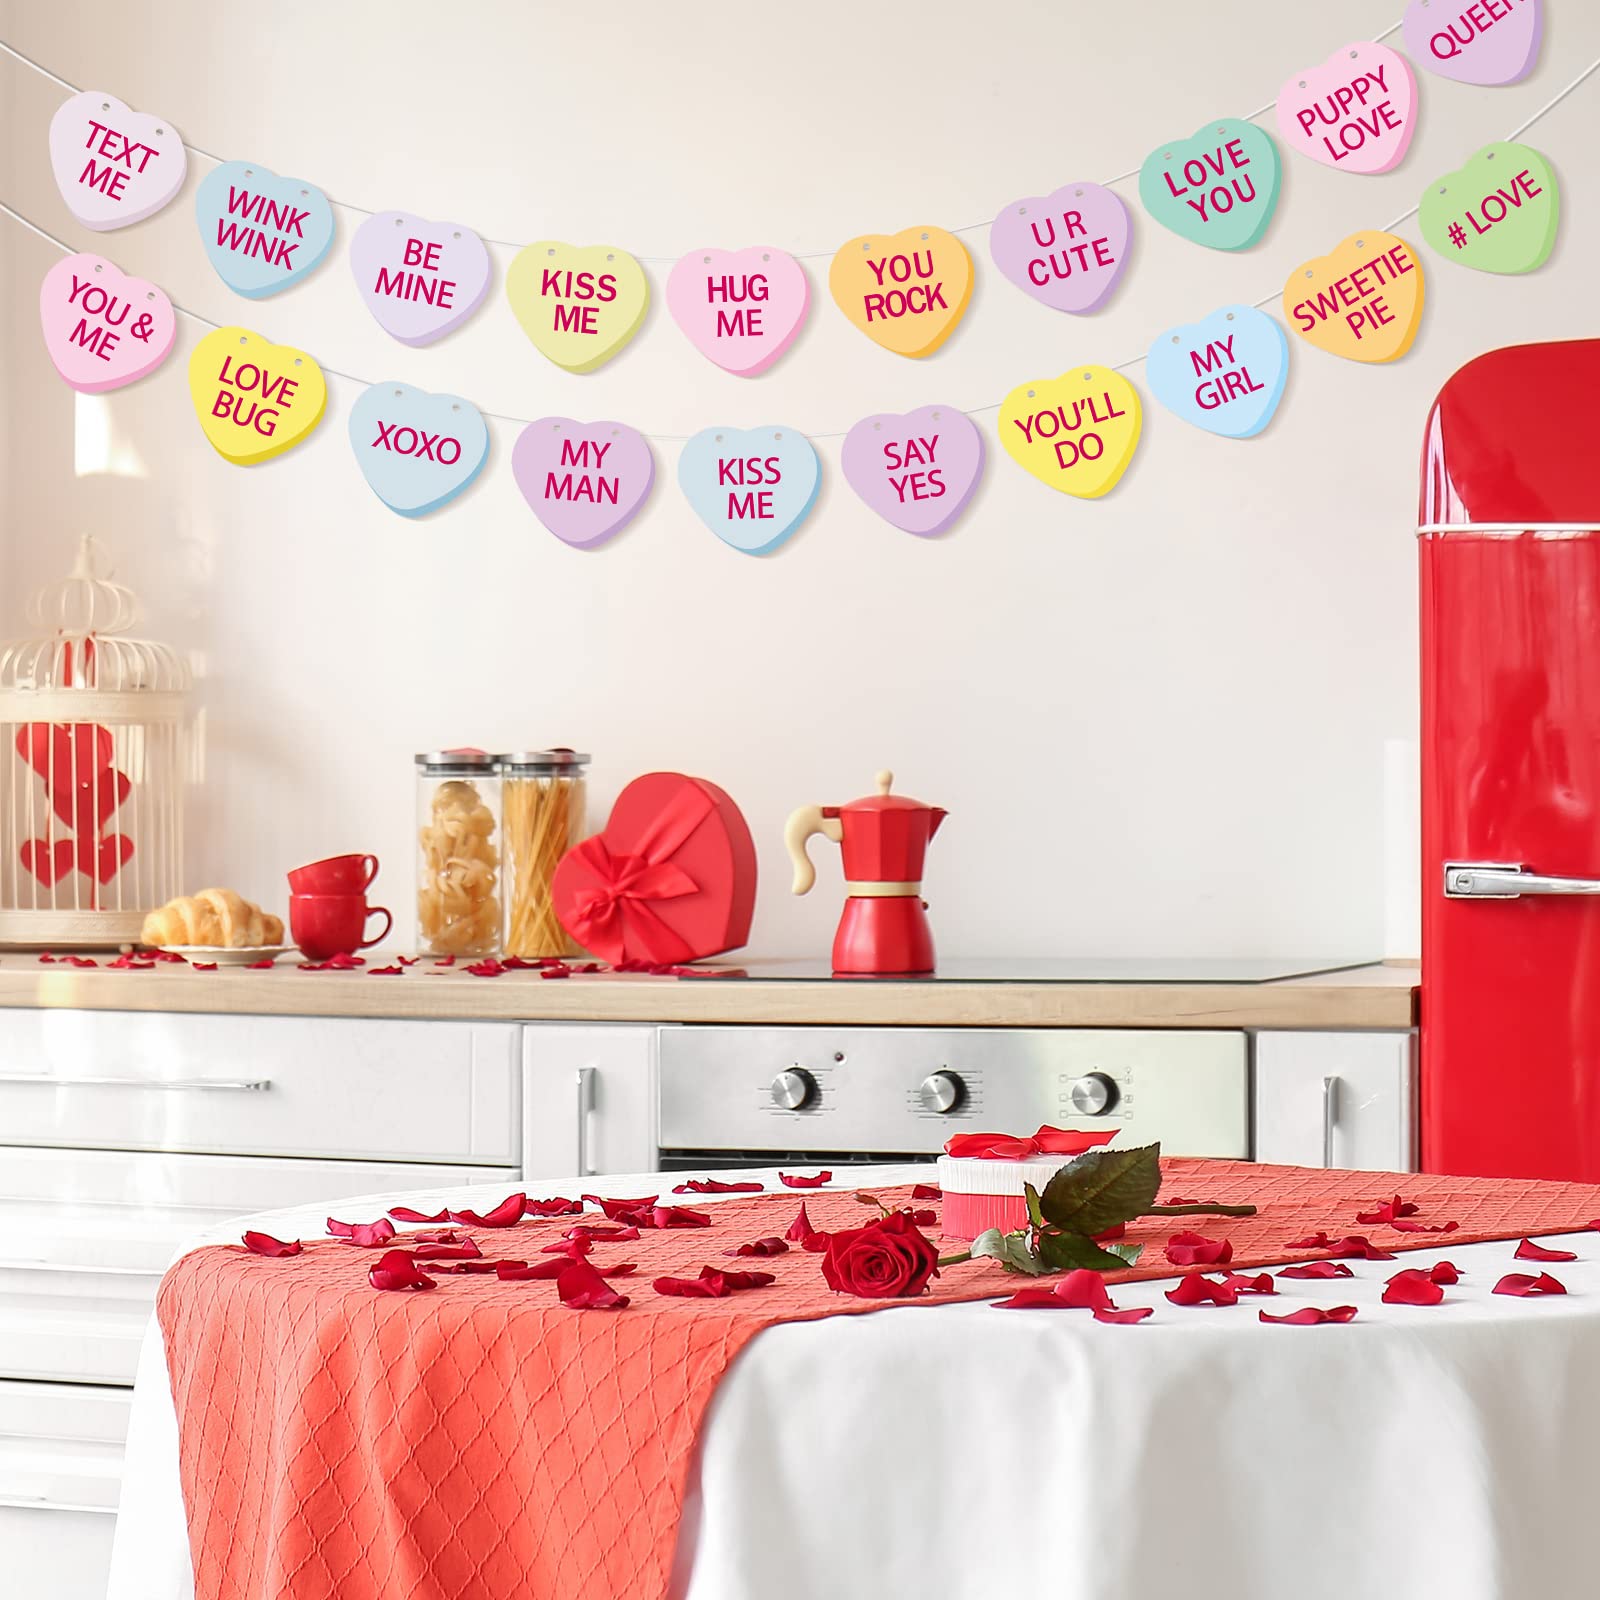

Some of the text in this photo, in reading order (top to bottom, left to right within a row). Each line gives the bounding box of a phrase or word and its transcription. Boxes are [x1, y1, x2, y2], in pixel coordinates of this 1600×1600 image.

[1297, 64, 1388, 137] PUPPY
[86, 120, 159, 173] TEXT
[1323, 100, 1402, 161] LOVE
[80, 159, 130, 200] ME
[1164, 139, 1250, 197] LOVE
[229, 186, 310, 238] WINK
[1187, 174, 1255, 222] YOU
[1448, 170, 1542, 248] # LOVE
[218, 219, 298, 270] WINK
[1031, 211, 1087, 247] U R
[404, 239, 442, 271] BE
[867, 252, 933, 285] YOU
[1028, 237, 1114, 286] CUTE
[375, 268, 456, 308] MINE
[542, 269, 616, 302] KISS
[708, 274, 768, 303] HUG
[864, 283, 948, 322] ROCK
[1293, 245, 1414, 332] SWEETIE
[69, 275, 154, 343] YOU &
[554, 305, 599, 334] ME
[718, 309, 763, 337] ME
[1346, 296, 1395, 339] PIE
[69, 319, 120, 361] ME
[1190, 336, 1234, 377] MY
[219, 356, 298, 408] LOVE
[1196, 367, 1264, 409] GIRL
[212, 390, 279, 436] BUG
[372, 421, 461, 464] XOXO
[561, 439, 611, 468] MY
[884, 435, 938, 470] SAY
[1054, 433, 1103, 469] DO
[545, 472, 619, 504] MAN
[719, 457, 781, 485] KISS
[889, 469, 945, 503] YES
[728, 492, 774, 519] ME
